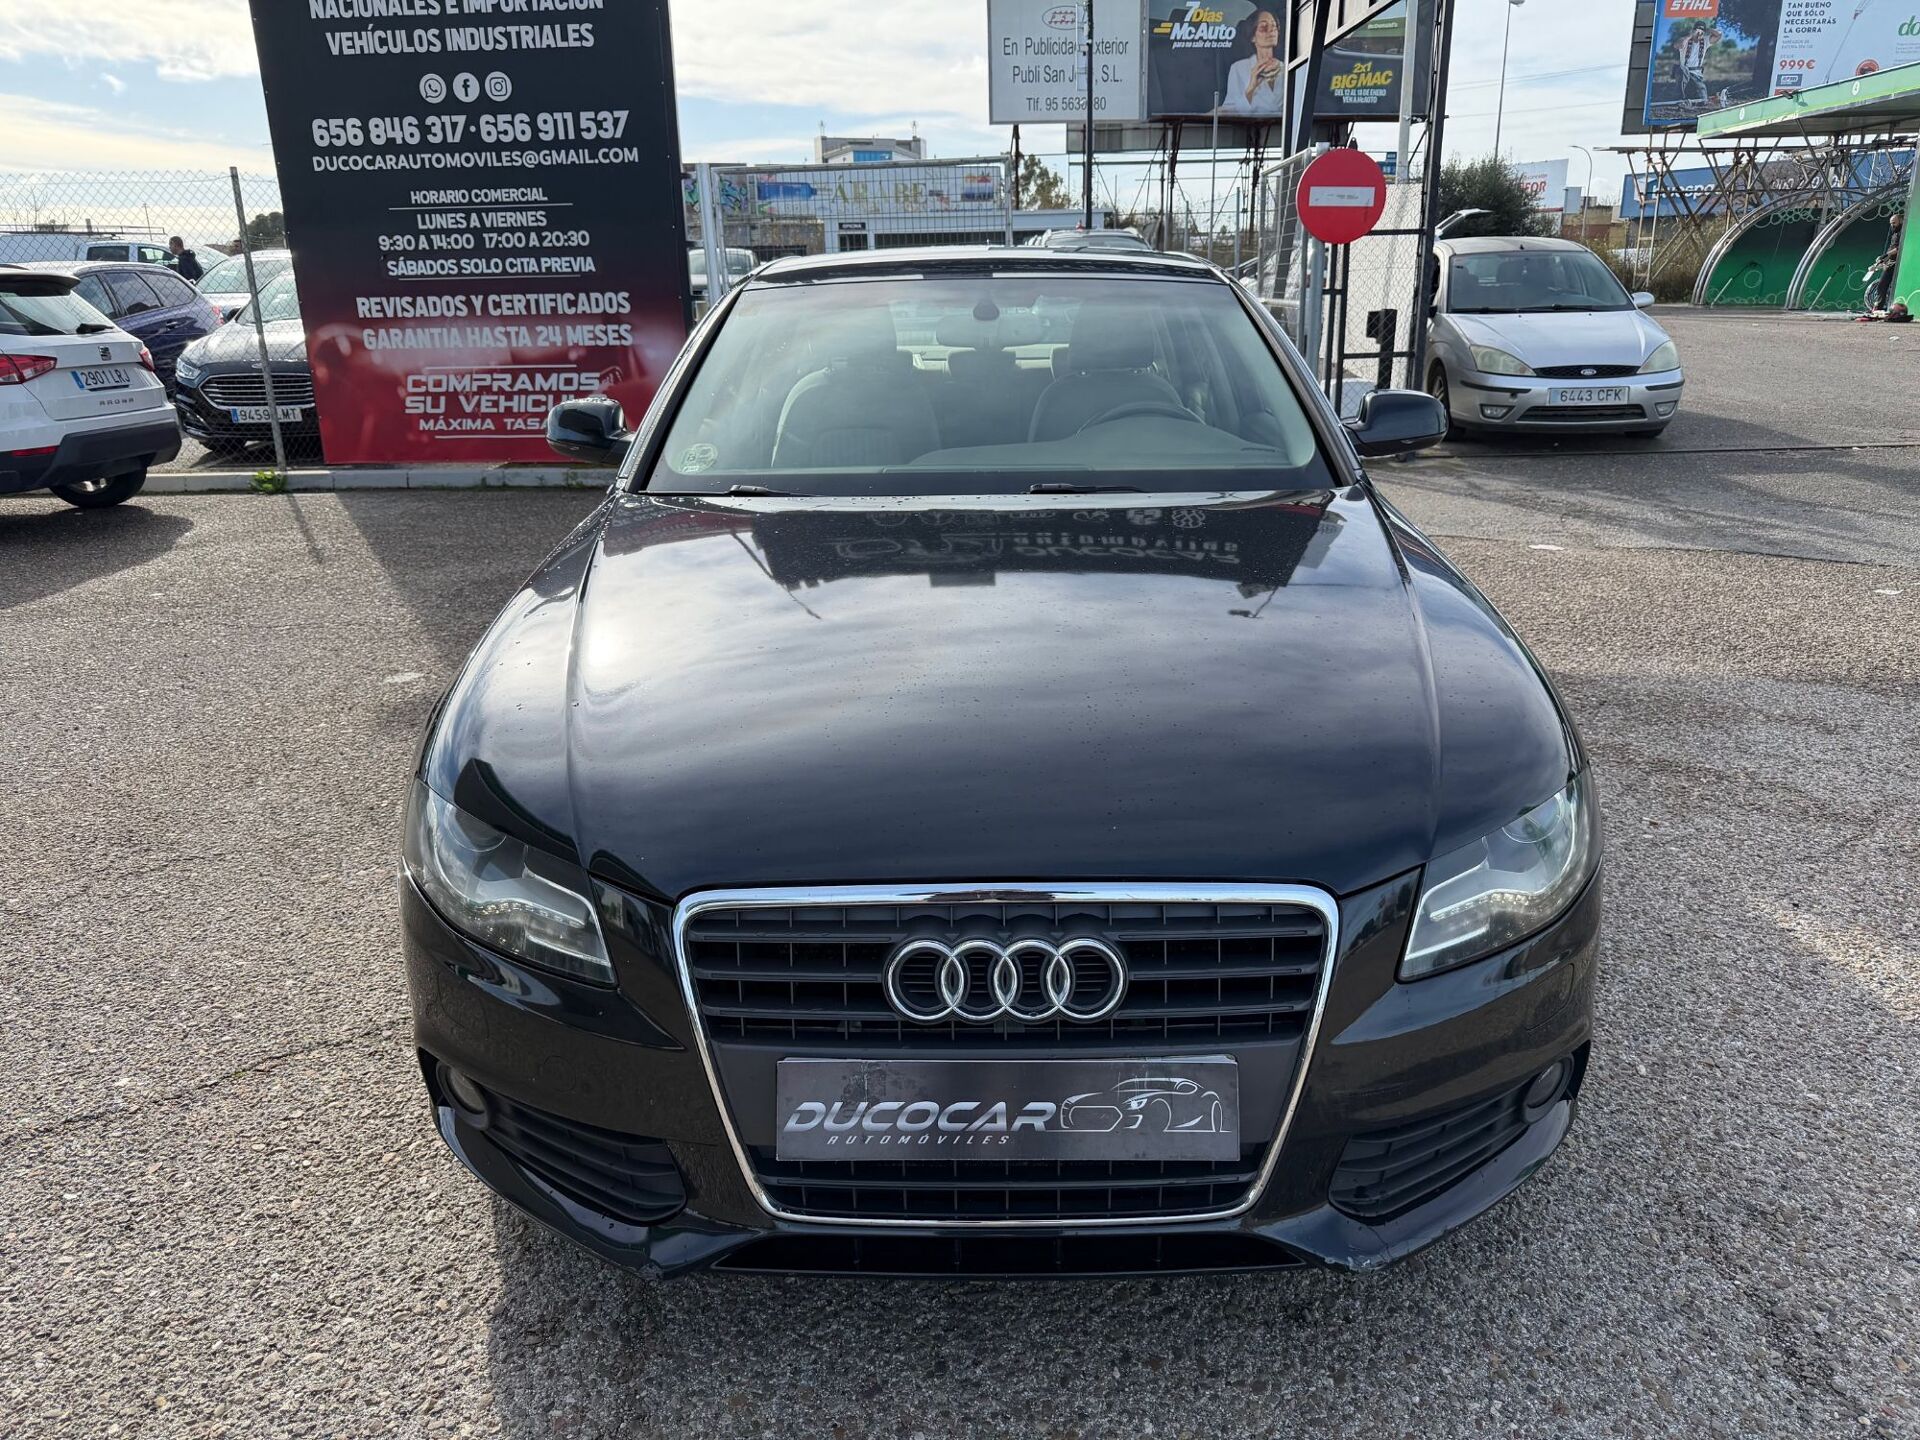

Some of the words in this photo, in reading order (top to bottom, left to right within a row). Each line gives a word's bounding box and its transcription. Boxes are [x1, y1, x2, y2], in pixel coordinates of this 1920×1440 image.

[309, 0, 441, 19] NACIONALES
[446, 0, 459, 14] E
[1184, 1, 1200, 21] 7
[1670, 0, 1713, 10] STIHL
[1804, 8, 1825, 17] SÓLO
[1805, 1, 1832, 9] BUENO
[1784, 17, 1837, 25] NECESITARÁS
[1795, 26, 1822, 34] GORRA
[325, 24, 442, 55] VEHÍCULOS
[445, 23, 595, 52] INDUSTRIALES
[1170, 22, 1237, 40] McAuto
[1003, 37, 1018, 56] En
[1094, 37, 1129, 55] xterior
[1012, 65, 1040, 83] Publi
[1044, 65, 1065, 83] San
[1101, 64, 1123, 83] S.L.
[1353, 62, 1373, 73] 2x1
[1780, 59, 1816, 70] 999€
[1331, 73, 1357, 90] BIG
[1357, 70, 1393, 87] MAC
[1026, 97, 1042, 112] Tlf.
[1045, 97, 1058, 111] 95
[1061, 96, 1107, 111] 56380
[312, 118, 364, 147] 656
[368, 116, 421, 145] 846
[536, 112, 576, 141] 911
[579, 110, 629, 139] 537
[312, 147, 639, 172] DUCOCARAUTOMOVILES@GMAIL.COM
[410, 190, 469, 205] HORARIO
[471, 188, 548, 202] COMERCIAL
[416, 212, 467, 230] LUNES
[469, 212, 481, 228] A
[481, 210, 548, 227] VIERNES
[378, 234, 415, 251] 9:30
[418, 234, 430, 250] A
[431, 232, 475, 250] 14:00
[482, 231, 526, 248] 17:00
[528, 231, 541, 247] A
[541, 230, 590, 247] 20:30
[387, 256, 458, 276] SÁBADOS
[460, 258, 502, 274] SOLO
[505, 257, 539, 273] CITA
[540, 256, 596, 273] PREVIA
[355, 295, 468, 319] REVISADOS
[470, 294, 485, 316] Y
[487, 291, 631, 316] CERTIFICADOS
[362, 326, 463, 350] GARANTIA
[466, 325, 531, 348] HASTA
[535, 325, 562, 346] 24
[565, 324, 633, 346] MESES
[80, 369, 110, 386] 2901
[109, 368, 131, 384] LRJ
[406, 371, 600, 393] COMPRAMOS
[1560, 390, 1593, 402] 6443
[1597, 388, 1622, 401] CFK
[404, 396, 446, 414] SU
[419, 415, 495, 431] MÁXIMA
[783, 1100, 1058, 1133] DUCOCAR
[827, 1132, 1011, 1145] AUTOMÓVILES
